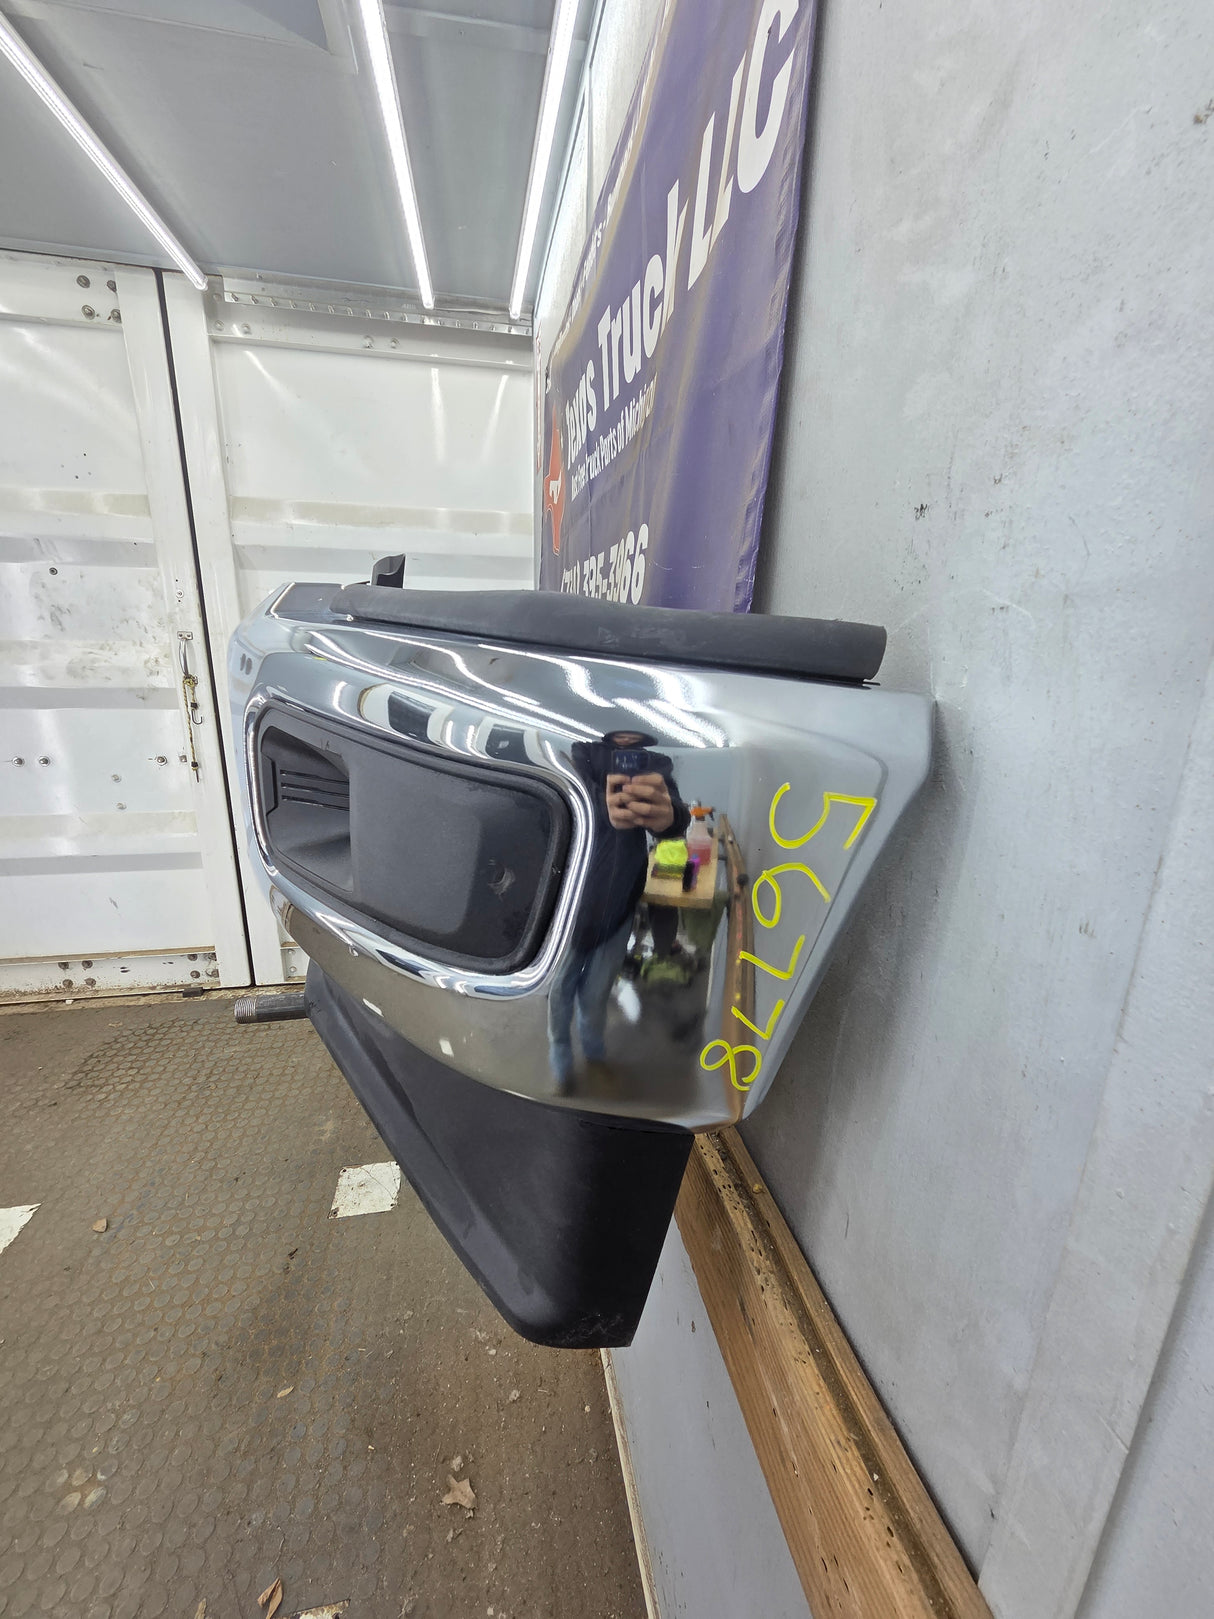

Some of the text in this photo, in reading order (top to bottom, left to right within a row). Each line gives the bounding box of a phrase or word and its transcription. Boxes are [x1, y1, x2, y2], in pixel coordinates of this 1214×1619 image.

[564, 359, 597, 471] Texas
[597, 179, 689, 411] Truck
[687, 0, 799, 291] LLC
[599, 434, 617, 470] Parts
[617, 410, 625, 453] of
